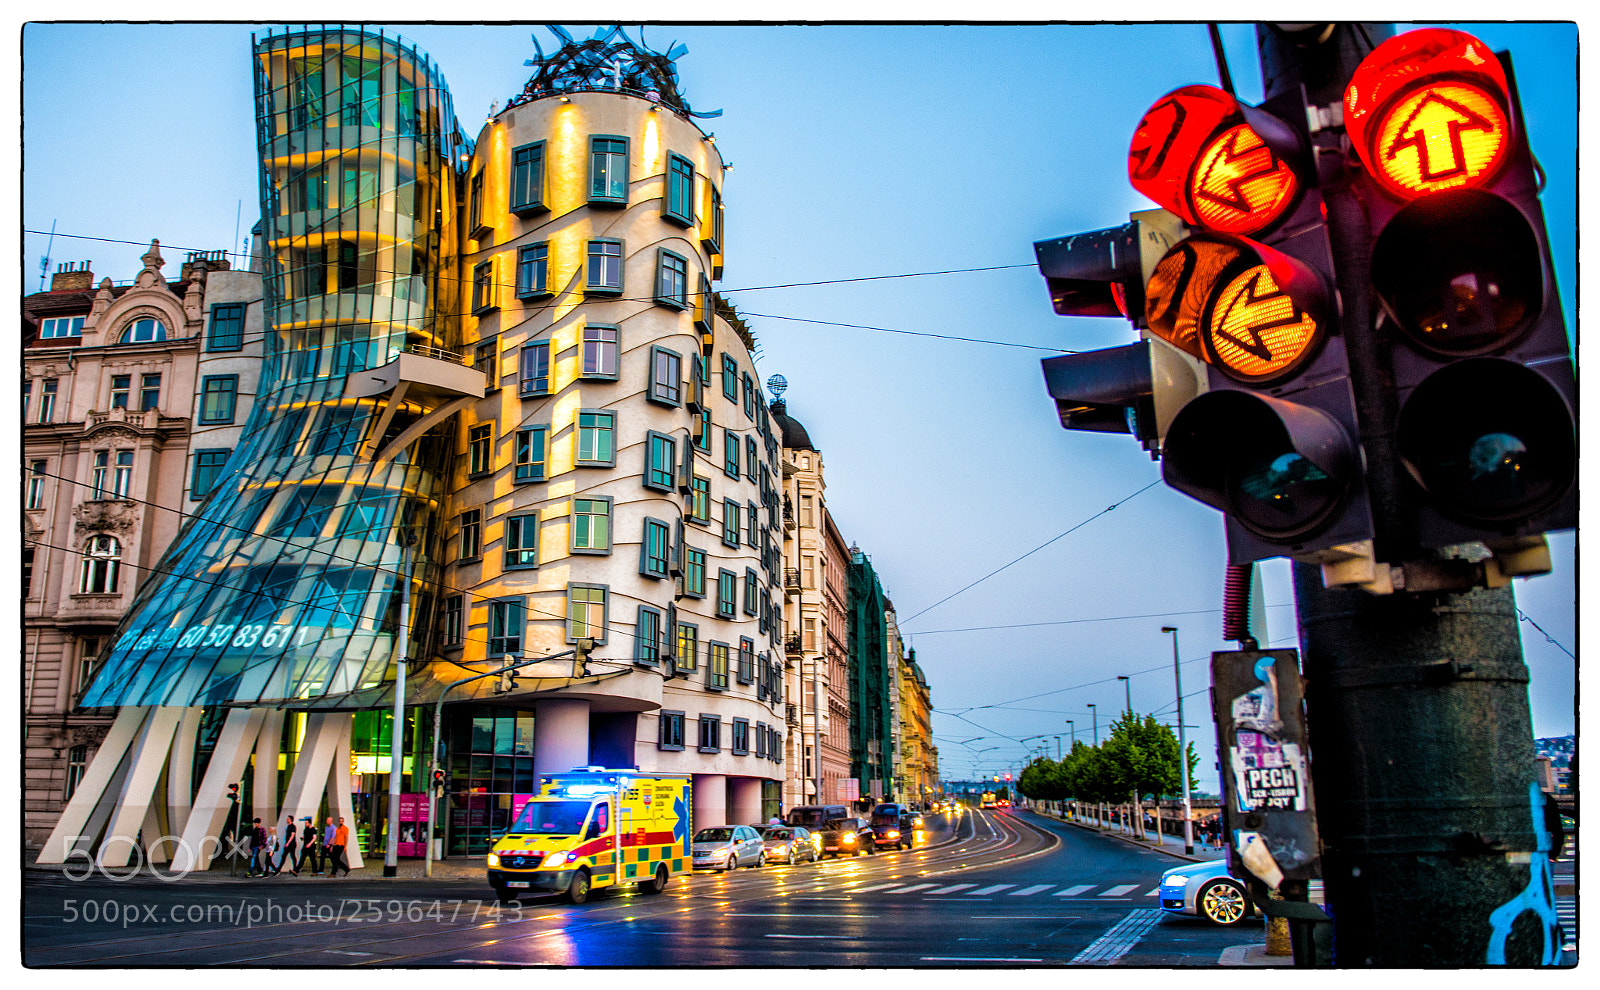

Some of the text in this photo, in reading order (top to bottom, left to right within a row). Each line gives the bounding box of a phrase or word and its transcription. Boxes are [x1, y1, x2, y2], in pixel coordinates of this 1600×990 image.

[177, 626, 208, 648] 60
[202, 624, 235, 647] 50
[232, 624, 264, 648] 83
[1249, 769, 1295, 788] PECH
